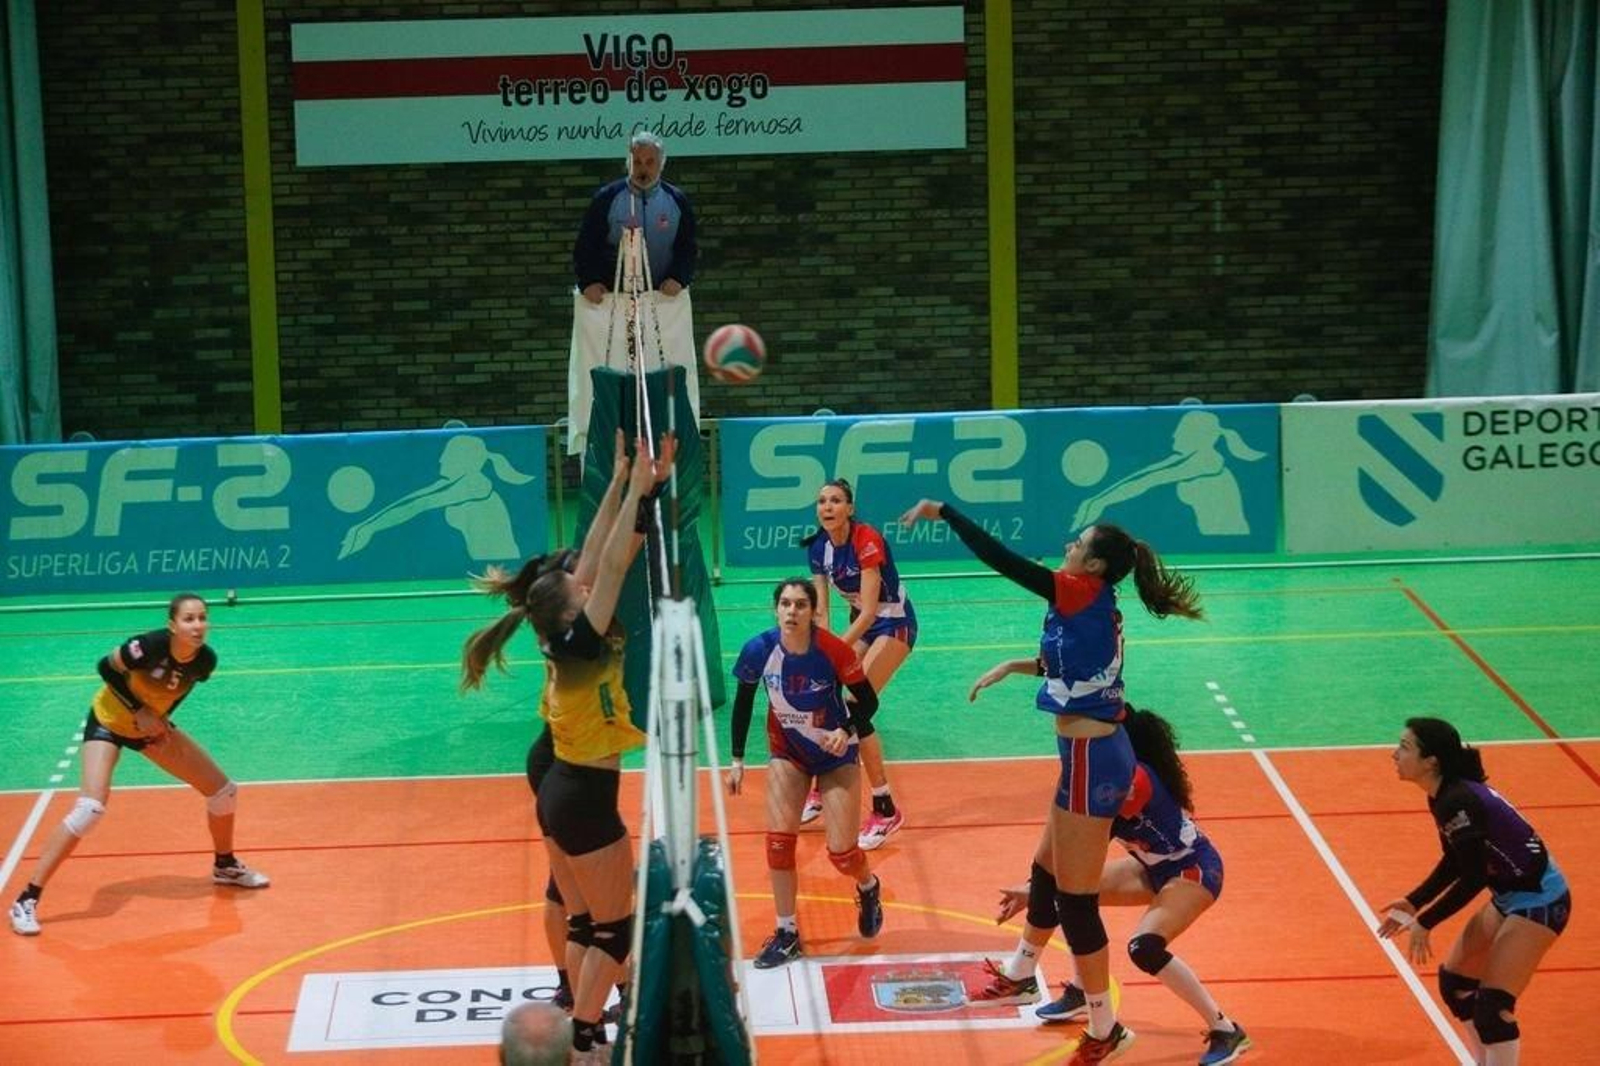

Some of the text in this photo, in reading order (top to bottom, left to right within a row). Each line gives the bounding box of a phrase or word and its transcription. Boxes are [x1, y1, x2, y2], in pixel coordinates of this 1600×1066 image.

[583, 33, 687, 74] VIGO,
[500, 70, 769, 108] terreo de xogo
[462, 111, 803, 144] Vivimos nunha cidade fermosa
[746, 415, 1028, 512] SF-2
[9, 443, 292, 540] SF-2
[743, 525, 818, 549] SUPER
[1010, 517, 1024, 541] 2
[7, 545, 291, 579] SUPERLIGA FEMENINA 2
[371, 986, 558, 1006] CONC
